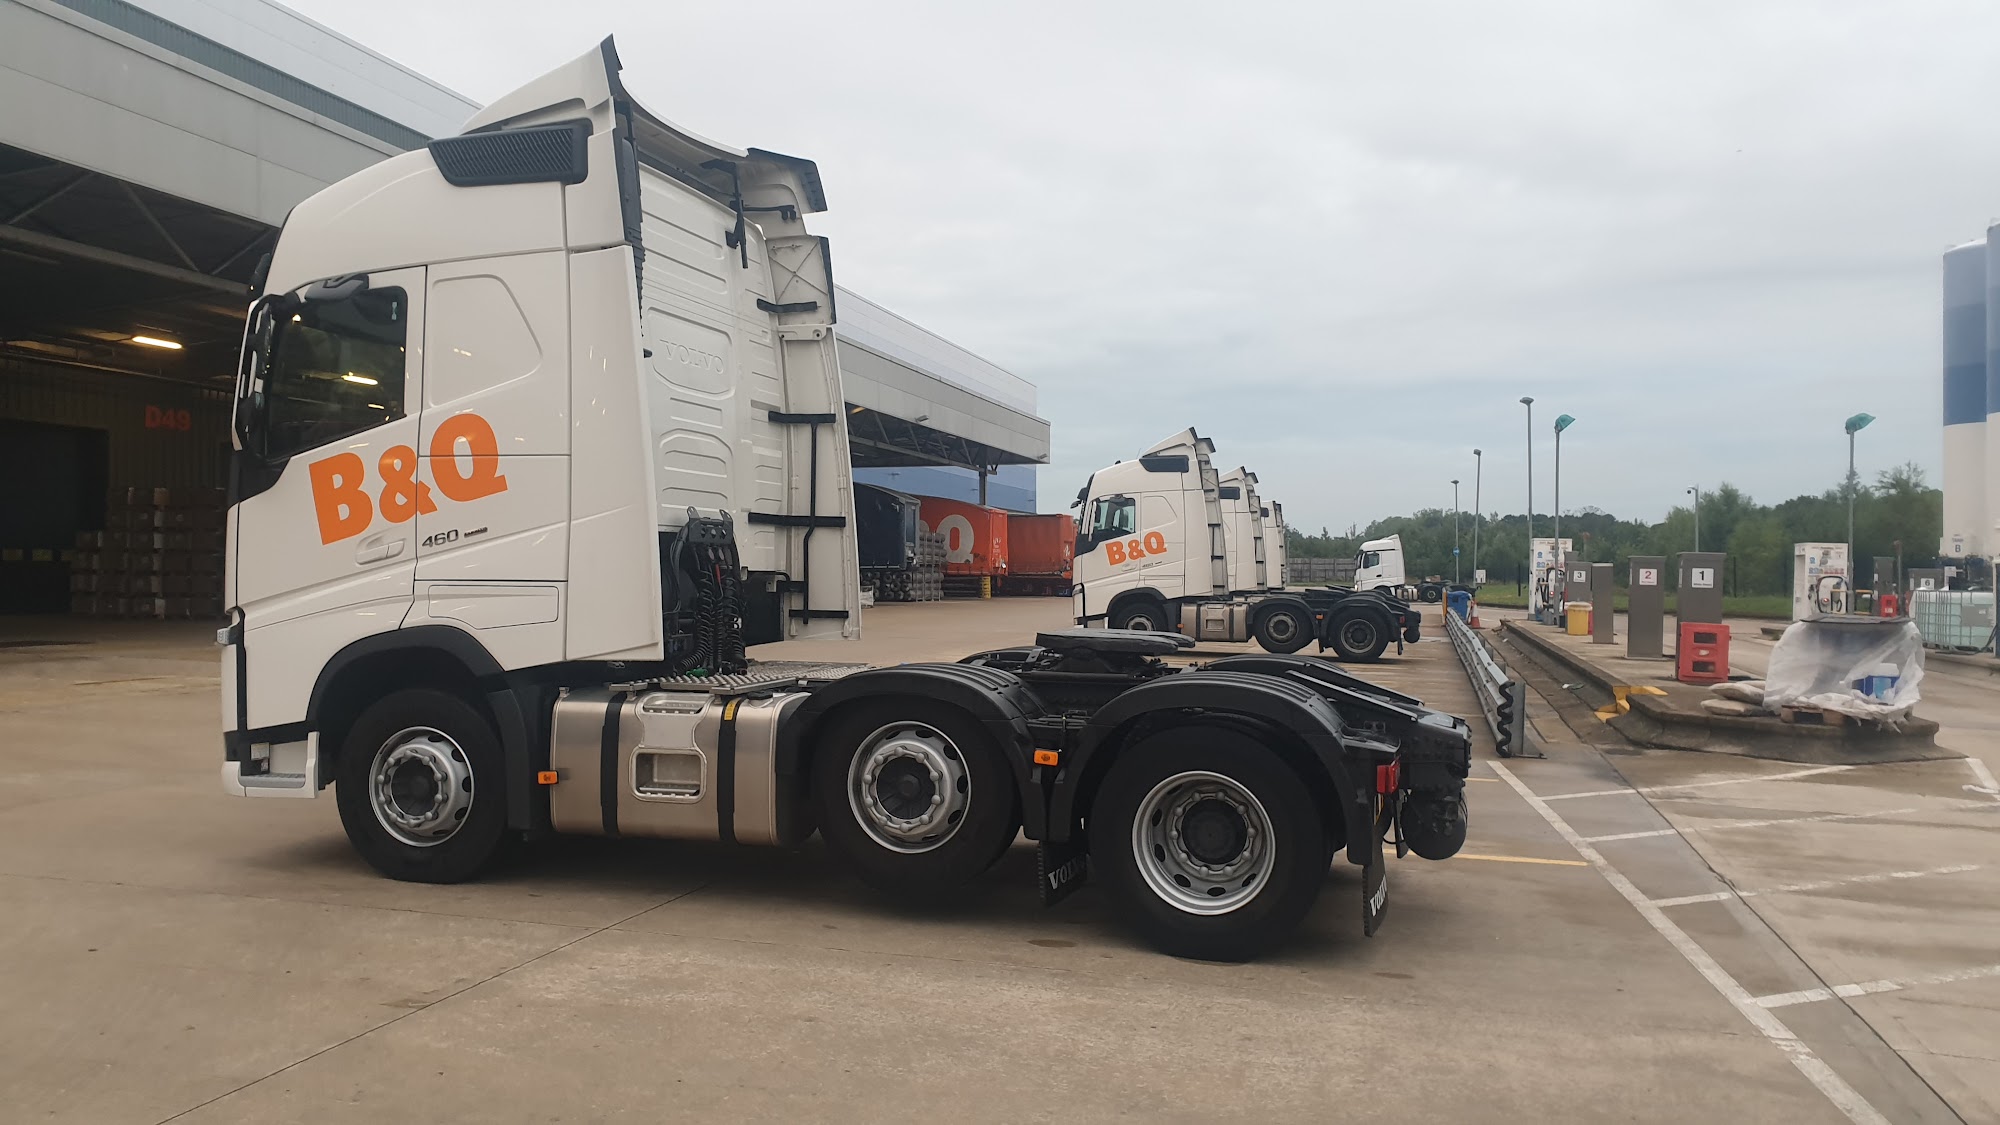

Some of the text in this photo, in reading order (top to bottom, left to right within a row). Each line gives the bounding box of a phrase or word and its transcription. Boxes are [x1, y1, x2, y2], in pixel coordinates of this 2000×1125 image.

[659, 339, 725, 374] VOLVO
[145, 405, 192, 432] D49
[308, 413, 508, 546] B&Q
[421, 529, 459, 548] 460
[1105, 531, 1168, 566] B&Q
[1577, 571, 1582, 579] 3
[1644, 570, 1652, 579] 2
[1699, 570, 1705, 581] 1
